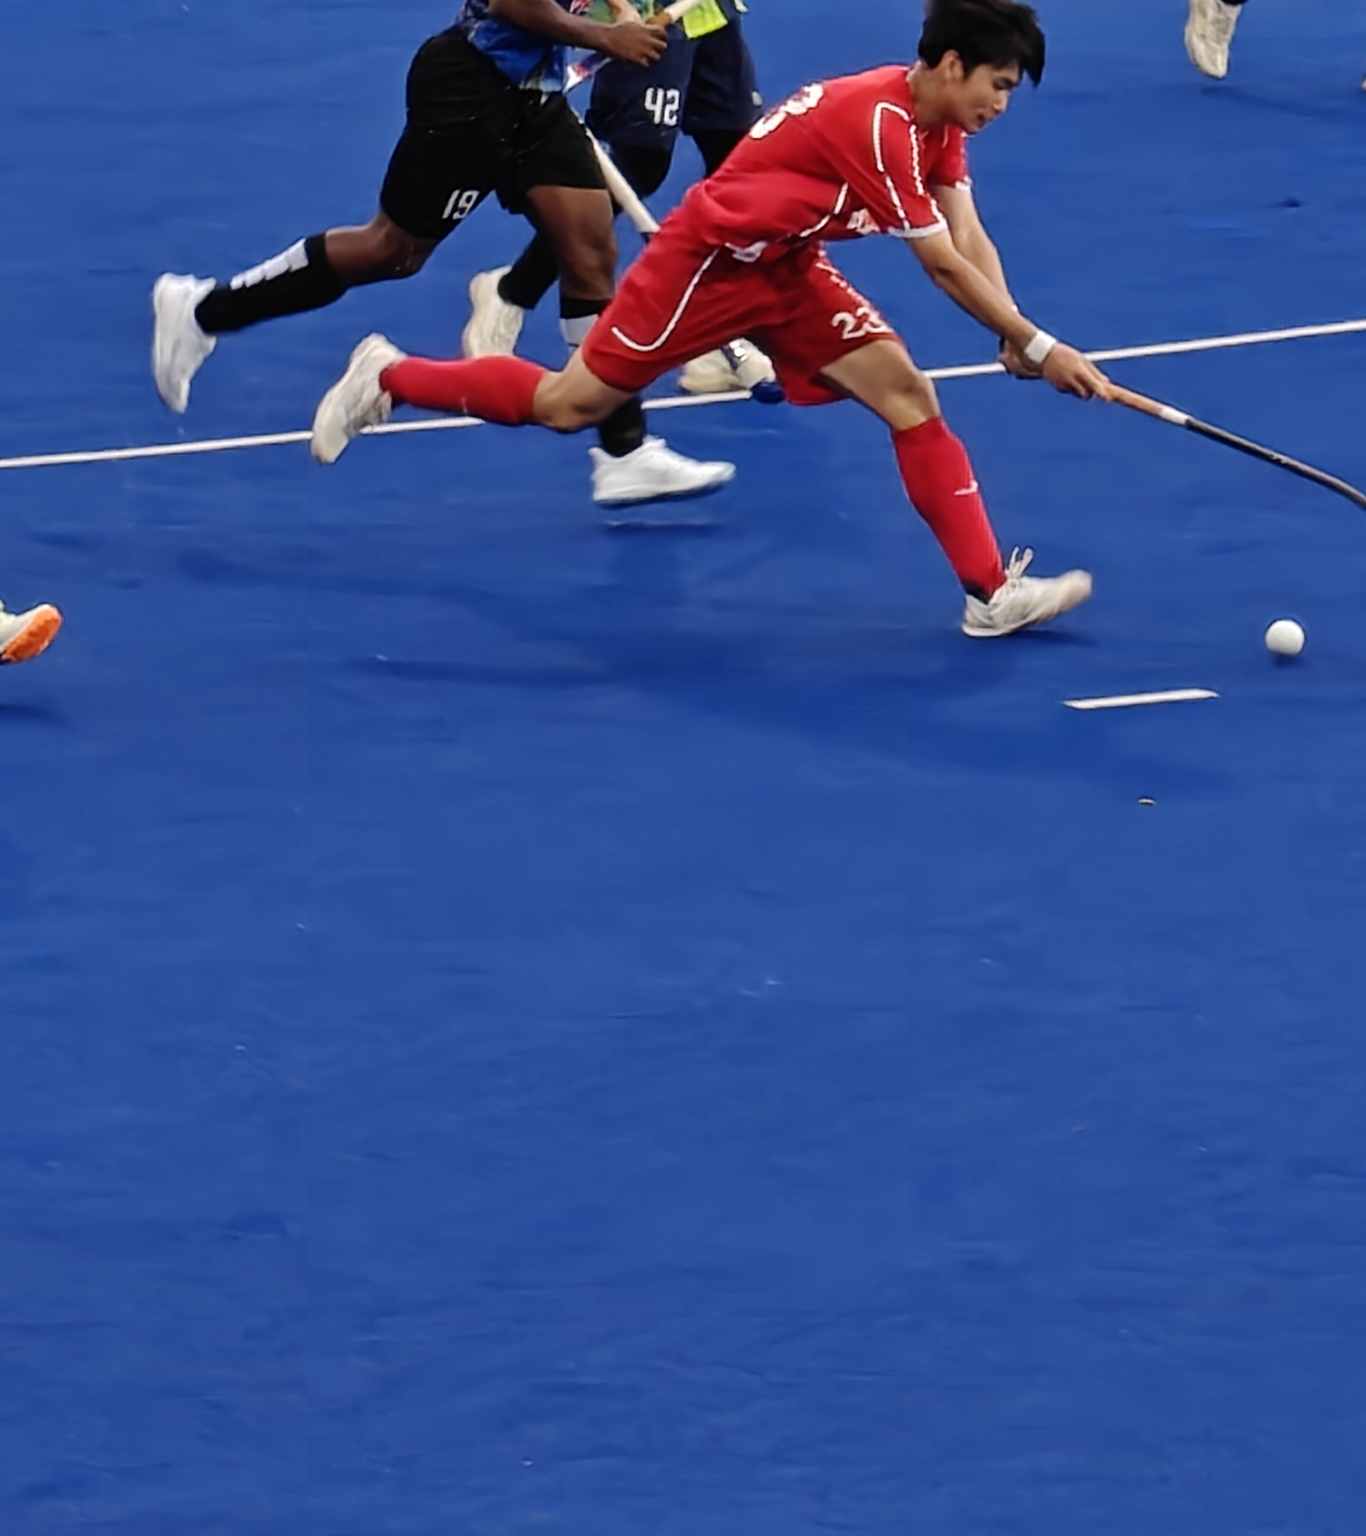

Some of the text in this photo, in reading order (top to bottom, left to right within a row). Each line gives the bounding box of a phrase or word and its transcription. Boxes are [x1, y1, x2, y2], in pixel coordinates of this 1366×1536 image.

[643, 87, 681, 125] 42
[442, 189, 480, 220] 19
[831, 306, 895, 340] 23
